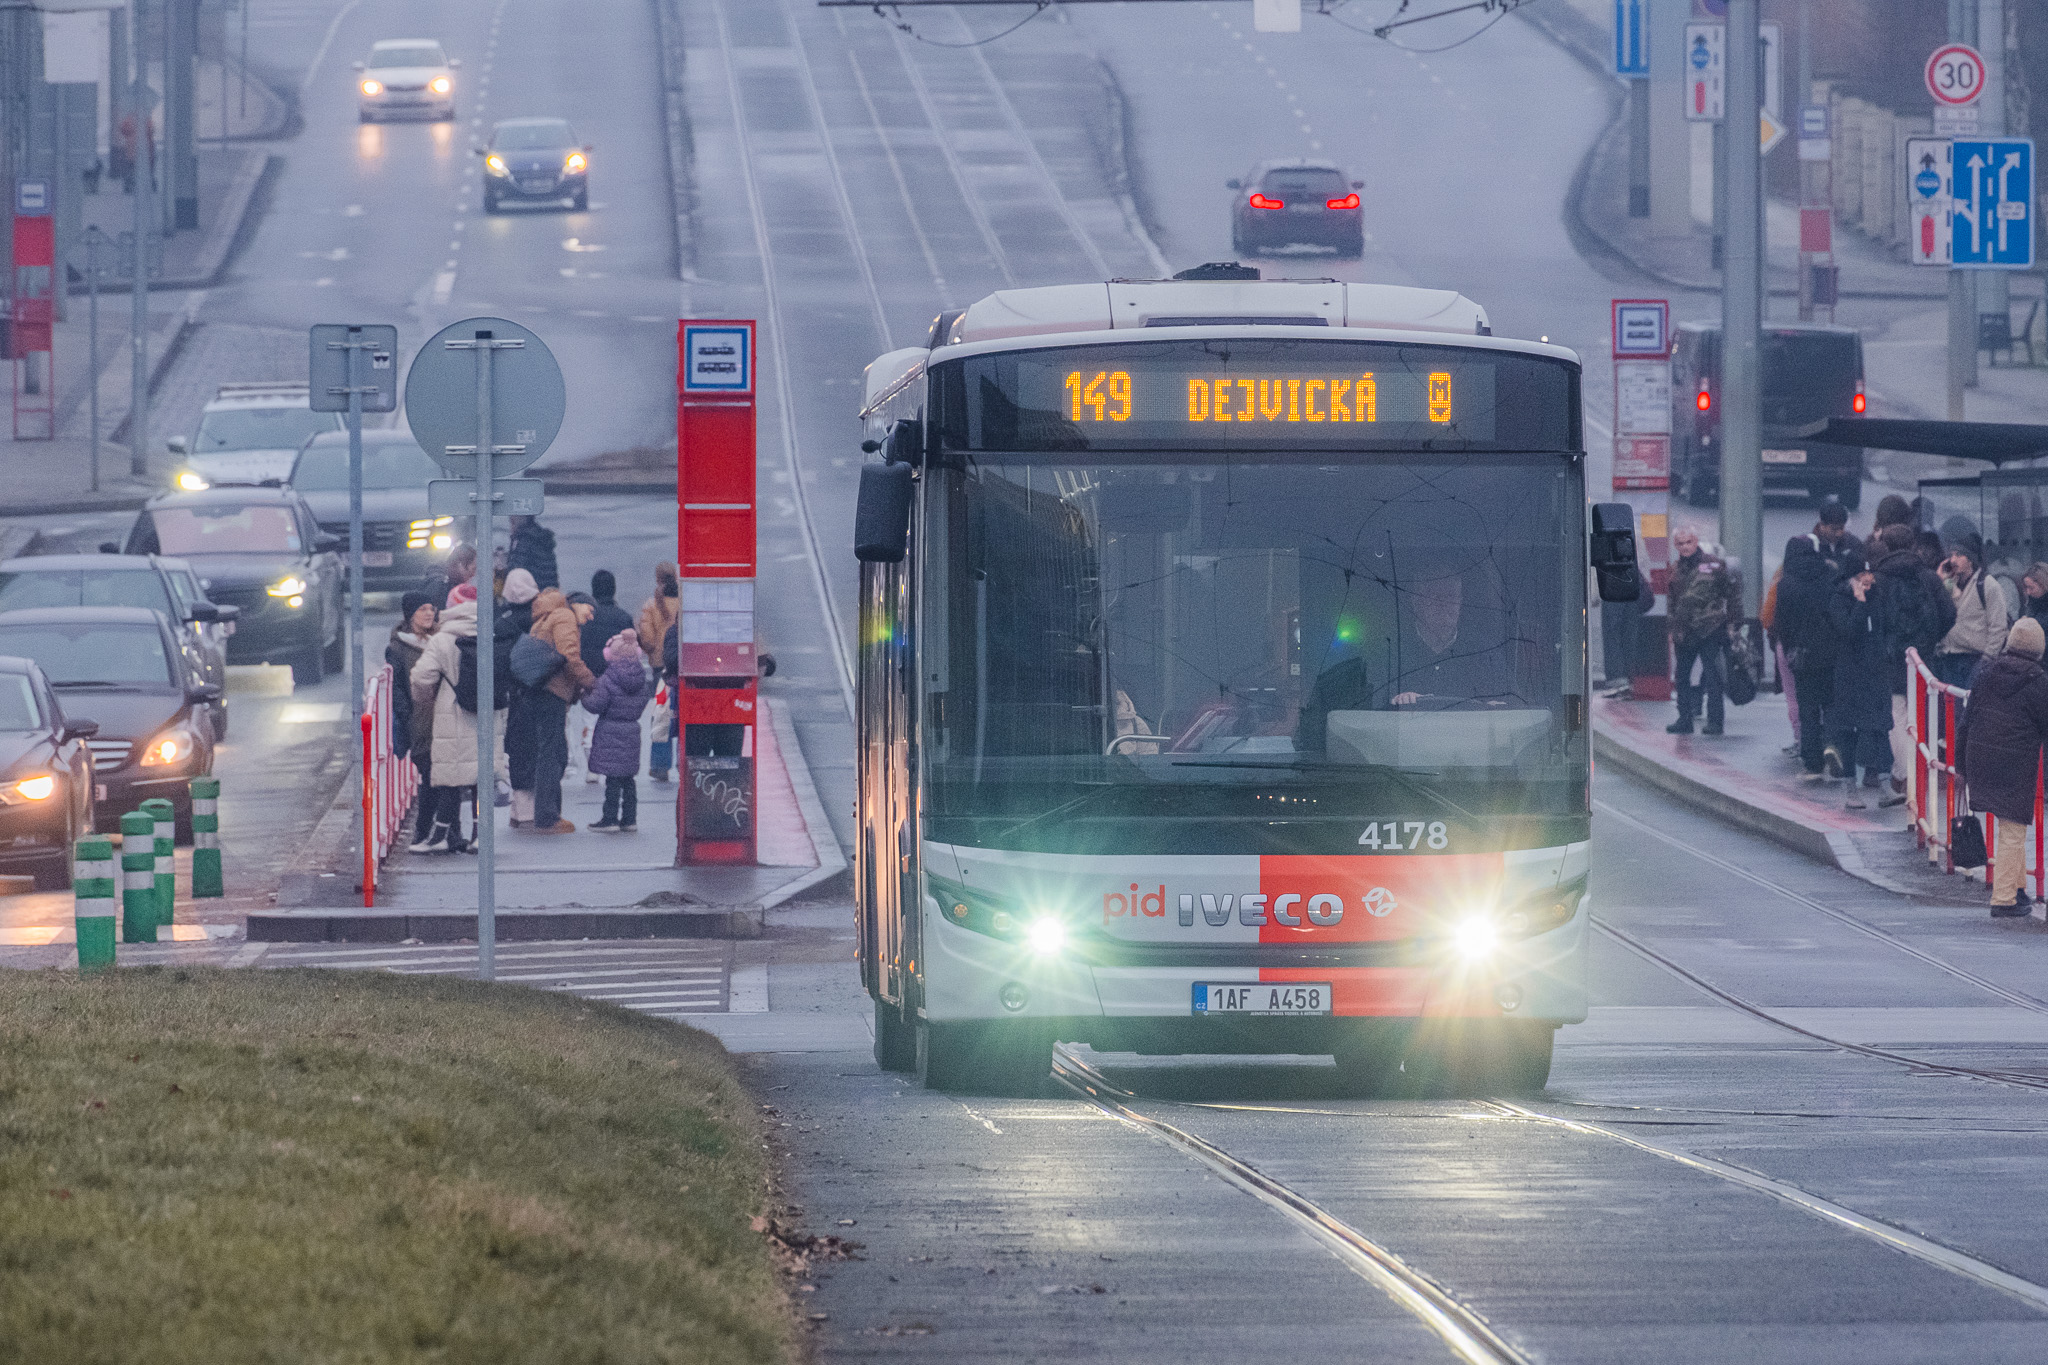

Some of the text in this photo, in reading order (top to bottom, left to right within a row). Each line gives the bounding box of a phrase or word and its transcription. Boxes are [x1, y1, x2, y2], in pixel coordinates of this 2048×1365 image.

[1940, 62, 1973, 89] 30
[1065, 371, 1132, 422] 149
[1188, 372, 1376, 422] DEJVICKÁ
[1358, 821, 1449, 850] 4178
[1102, 883, 1166, 925] pid
[1178, 893, 1344, 927] IVECO
[1196, 1002, 1206, 1010] CZ
[1214, 988, 1320, 1010] 1AF A458
